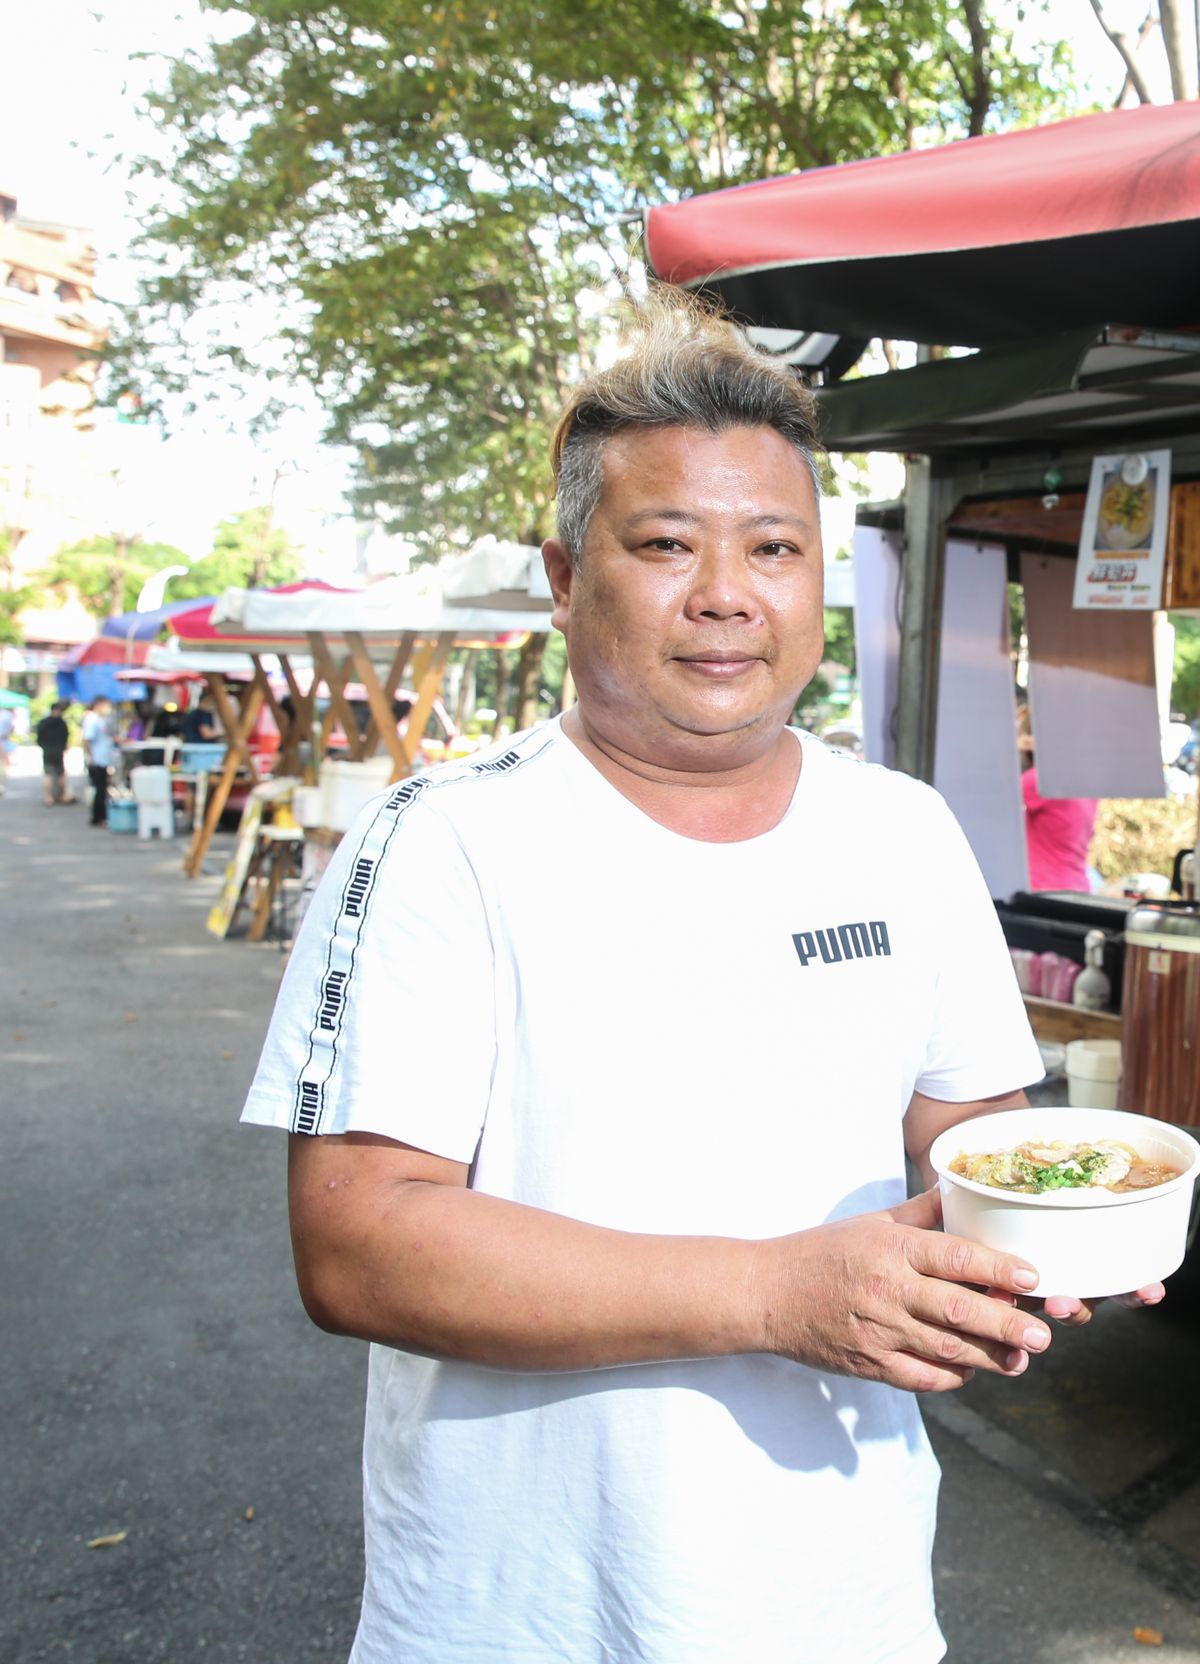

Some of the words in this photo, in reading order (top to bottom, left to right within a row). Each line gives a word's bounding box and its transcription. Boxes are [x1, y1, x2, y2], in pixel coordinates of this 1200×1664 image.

[344, 858, 374, 918] PUMA
[792, 921, 891, 966] PUMA
[320, 970, 347, 1031] PUMA
